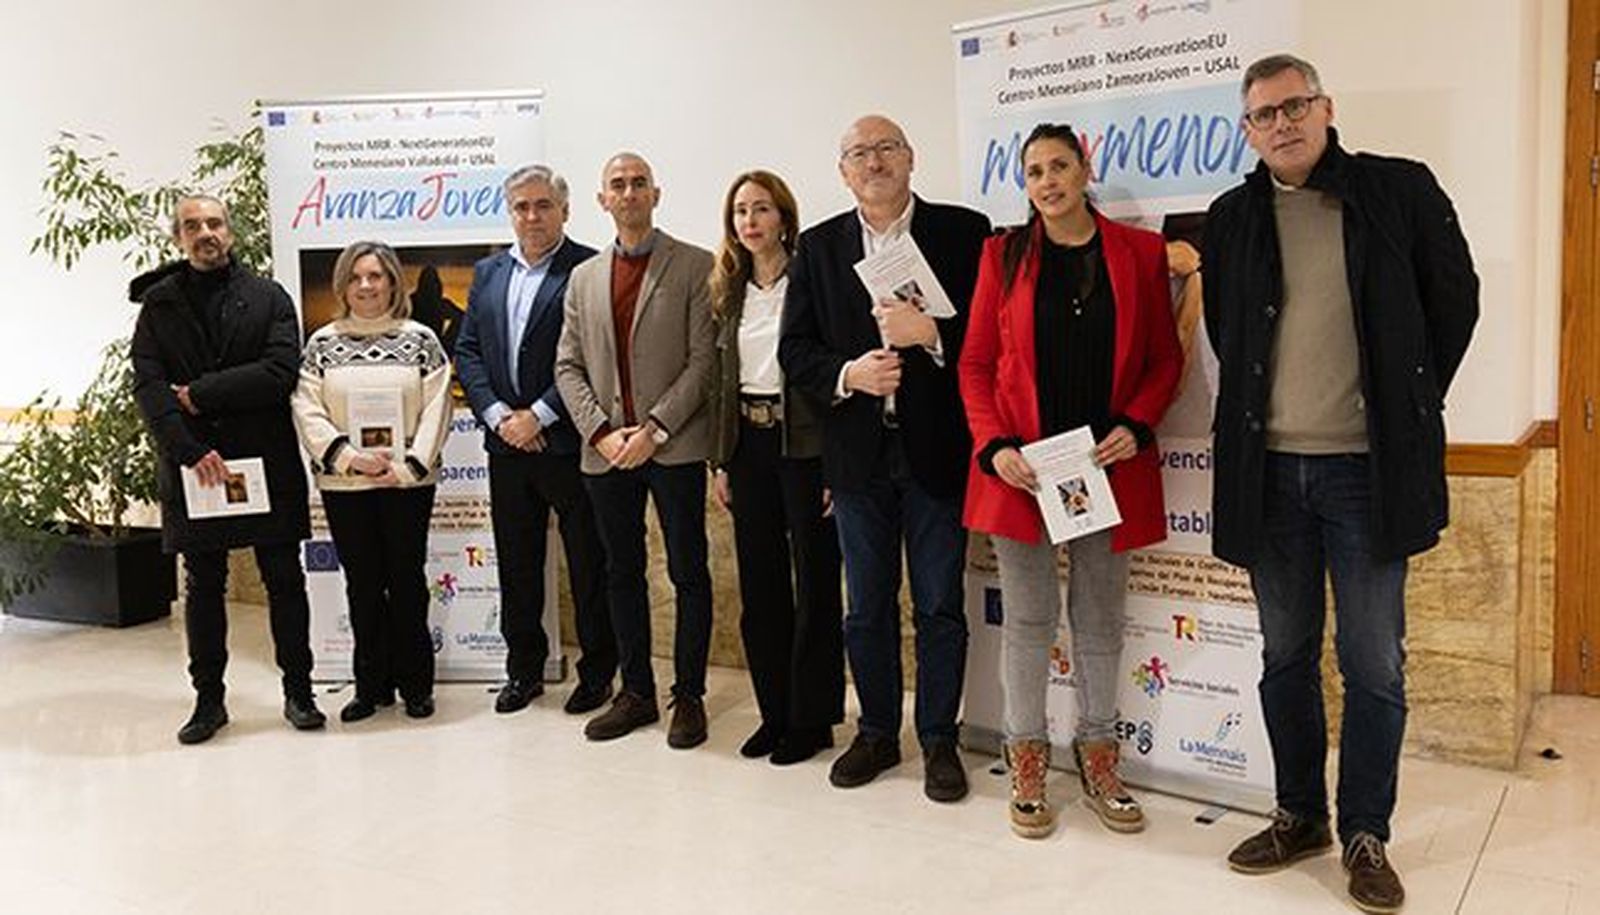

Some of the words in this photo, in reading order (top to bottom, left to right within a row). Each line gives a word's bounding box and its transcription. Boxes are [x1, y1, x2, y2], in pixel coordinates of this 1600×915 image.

[1008, 61, 1065, 80] Proyectos
[1067, 54, 1096, 71] MRR
[1106, 34, 1227, 64] NextGenerationEU
[998, 89, 1034, 105] Centro
[1038, 79, 1101, 98] Menesiano
[1106, 65, 1190, 89] ZamoraJoven
[1204, 56, 1240, 74] USAL
[314, 140, 364, 152] Proyectos
[366, 140, 391, 150] MRR
[400, 136, 495, 149] NextGenerationEU
[313, 158, 348, 170] Centro
[350, 157, 405, 169] Menesiano
[408, 155, 459, 167] Valladolid
[470, 154, 496, 165] USAL
[1169, 511, 1210, 534] tabl
